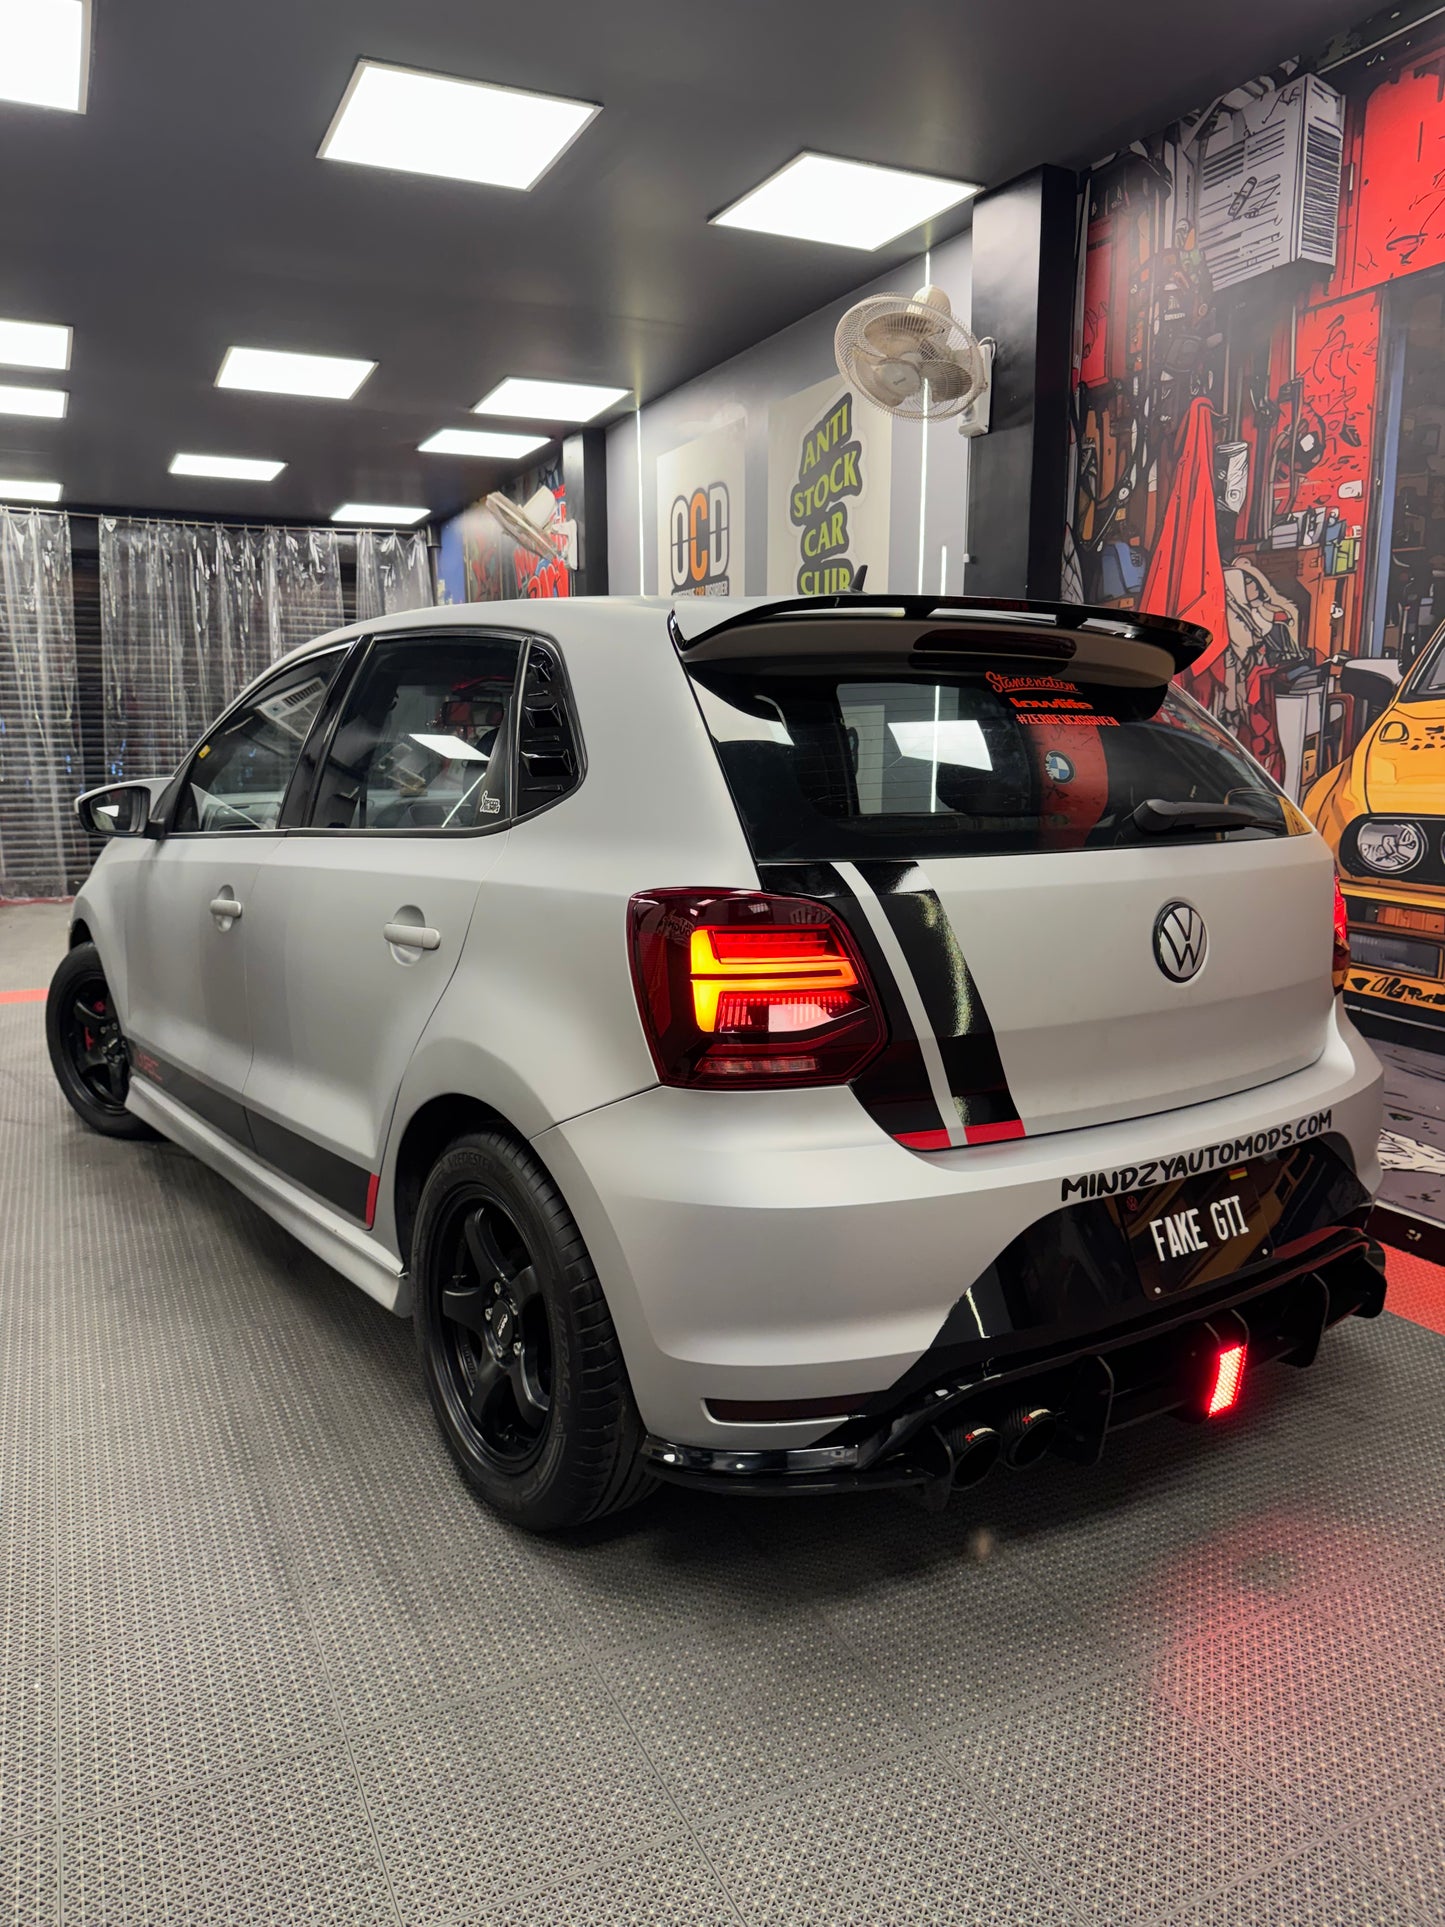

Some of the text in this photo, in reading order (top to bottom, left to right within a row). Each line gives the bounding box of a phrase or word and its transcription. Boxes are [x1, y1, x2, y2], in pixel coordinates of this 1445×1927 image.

[803, 403, 848, 475] ANTI
[793, 449, 858, 519] STOCK
[671, 483, 729, 588] OCD
[803, 510, 845, 557] CAR
[800, 567, 851, 595] CLUB
[985, 671, 1079, 693] Stancenation
[1061, 1109, 1332, 1202] MINDZYAUTOMODS.COM
[1149, 1195, 1250, 1262] FAKE GTI
